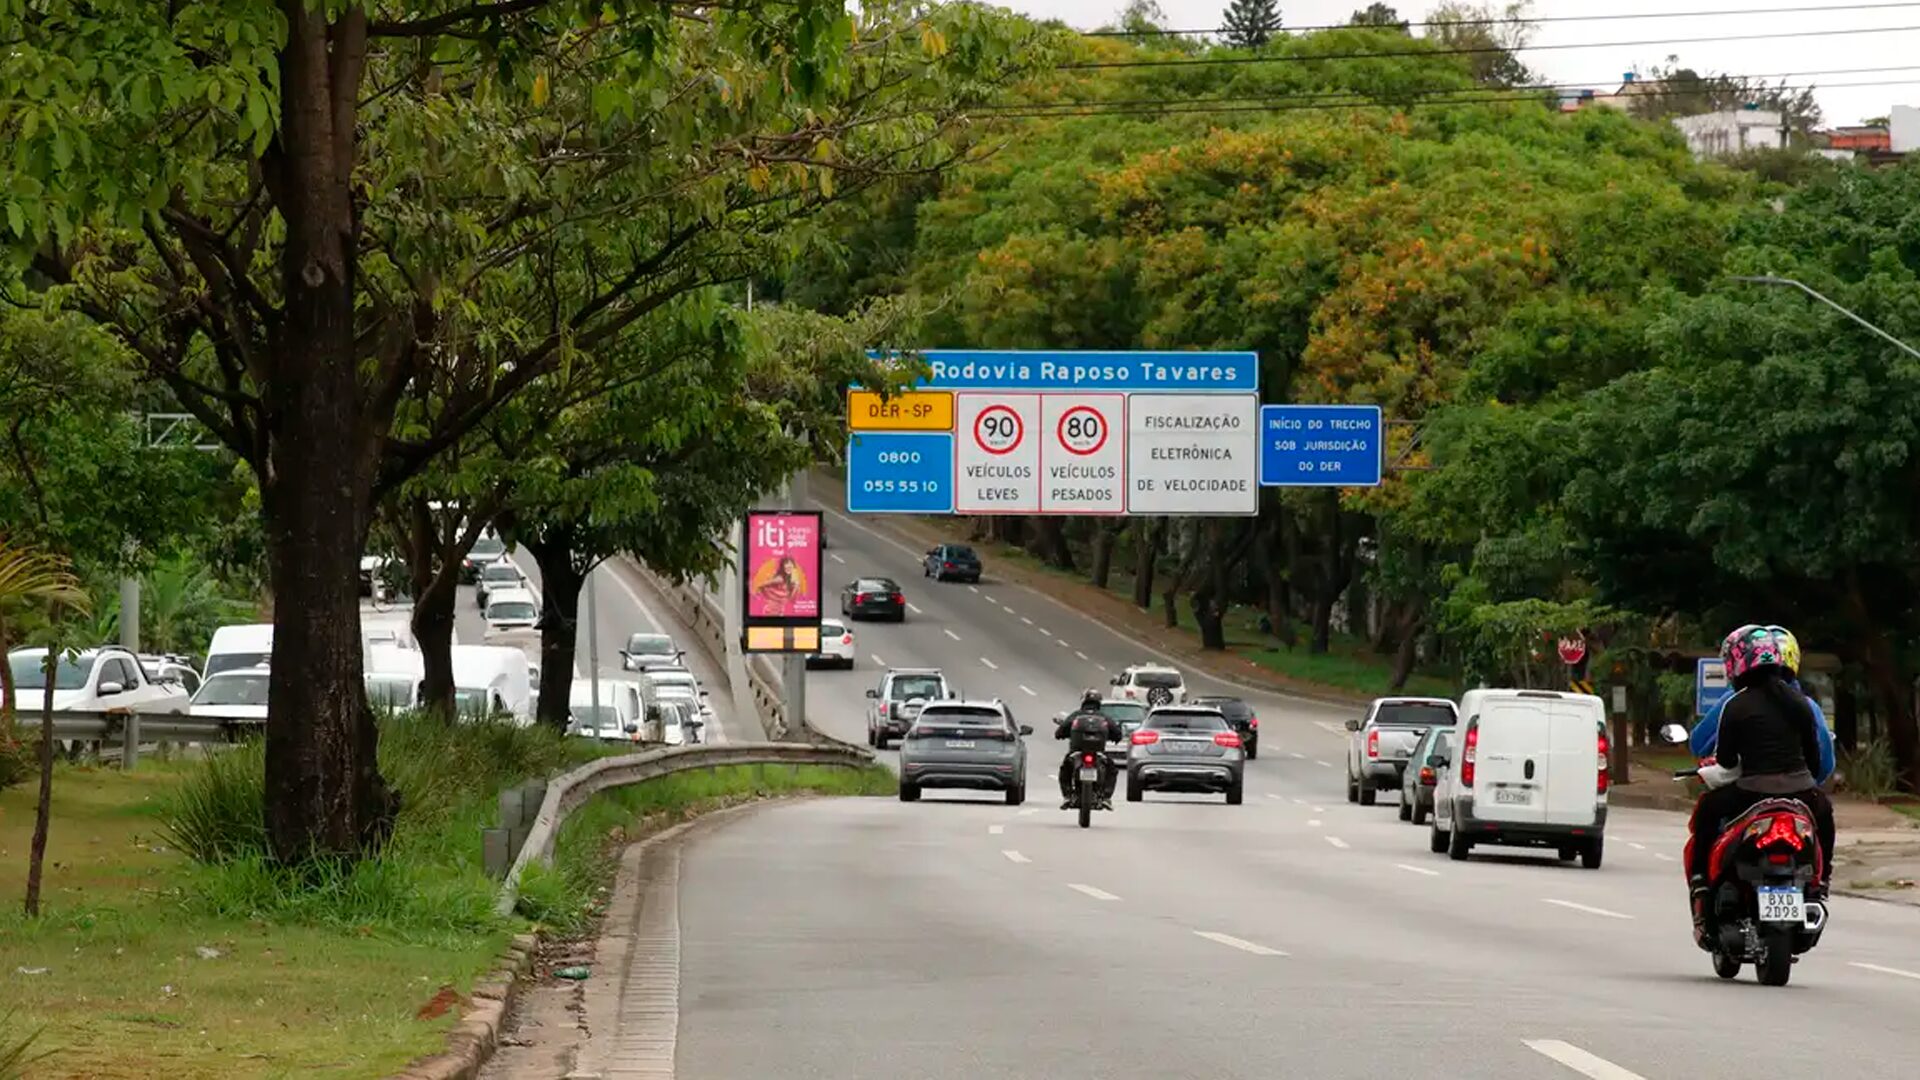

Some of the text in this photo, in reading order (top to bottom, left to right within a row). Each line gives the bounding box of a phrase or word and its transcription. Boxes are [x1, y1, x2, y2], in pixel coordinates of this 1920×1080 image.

[932, 362, 1237, 383] Rodovia Raposo Tavares
[984, 416, 1014, 438] 90
[1067, 417, 1098, 438] 80
[1145, 413, 1240, 430] FISCALIZAÇÃO
[1269, 415, 1372, 430] INÍCIO DO TRECHO
[1151, 444, 1232, 460] ELETRÔNICA
[1274, 438, 1367, 452] SOB JURISDIÇÃO
[878, 451, 921, 464] 0800
[966, 462, 1031, 478] VEÍCULOS
[1050, 463, 1116, 479] VEÍCULOS
[1298, 461, 1342, 471] DO DER
[1138, 479, 1247, 492] DE VELOCIDADE
[978, 488, 1019, 500] LEVES
[1052, 489, 1113, 501] PESADOS
[758, 519, 785, 547] iti
[1768, 894, 1794, 906] BXD
